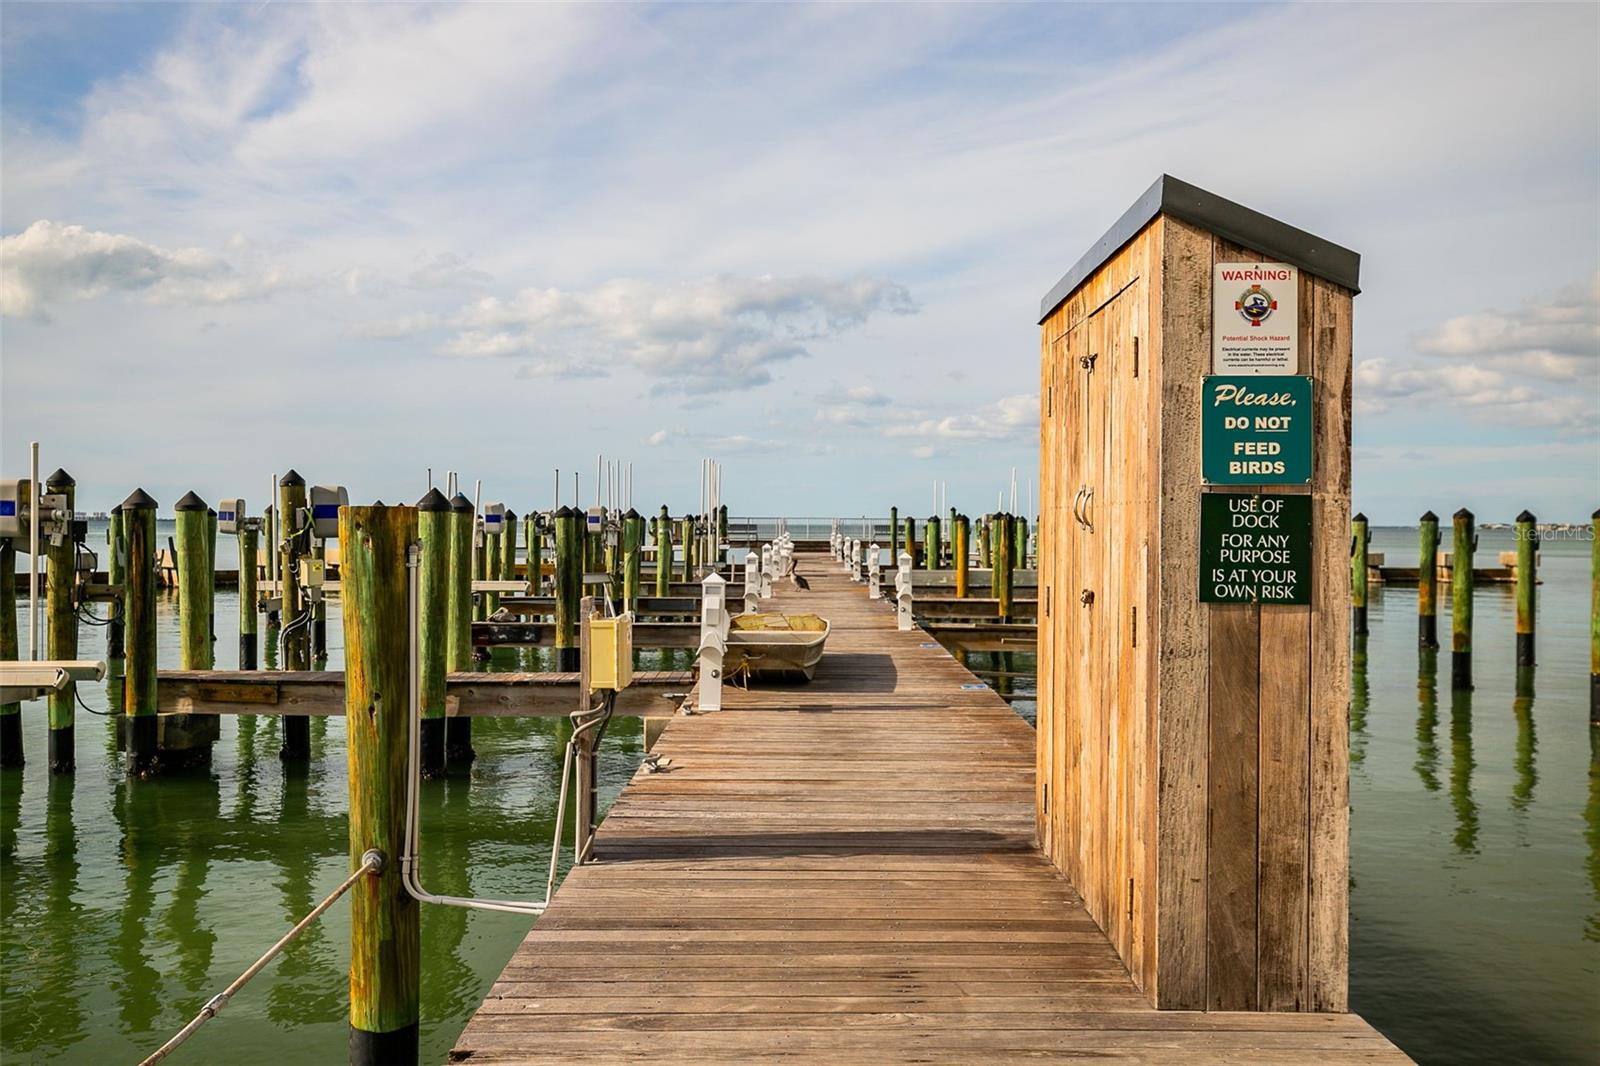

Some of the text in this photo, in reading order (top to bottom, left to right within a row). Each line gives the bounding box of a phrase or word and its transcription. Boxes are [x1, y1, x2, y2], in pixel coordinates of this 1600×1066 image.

[1222, 270, 1291, 281] WARNING!
[1224, 416, 1292, 430] DO NOT
[1234, 442, 1280, 455] FEED
[1230, 461, 1286, 474] BIRDS
[1229, 499, 1284, 513] USE OF
[1232, 514, 1280, 528] DOCK
[1222, 534, 1290, 548] FOR ANY
[1220, 549, 1290, 564] PURPOSE
[1212, 568, 1296, 584] IS AT YOUR
[1214, 584, 1294, 599] OWN RISK
